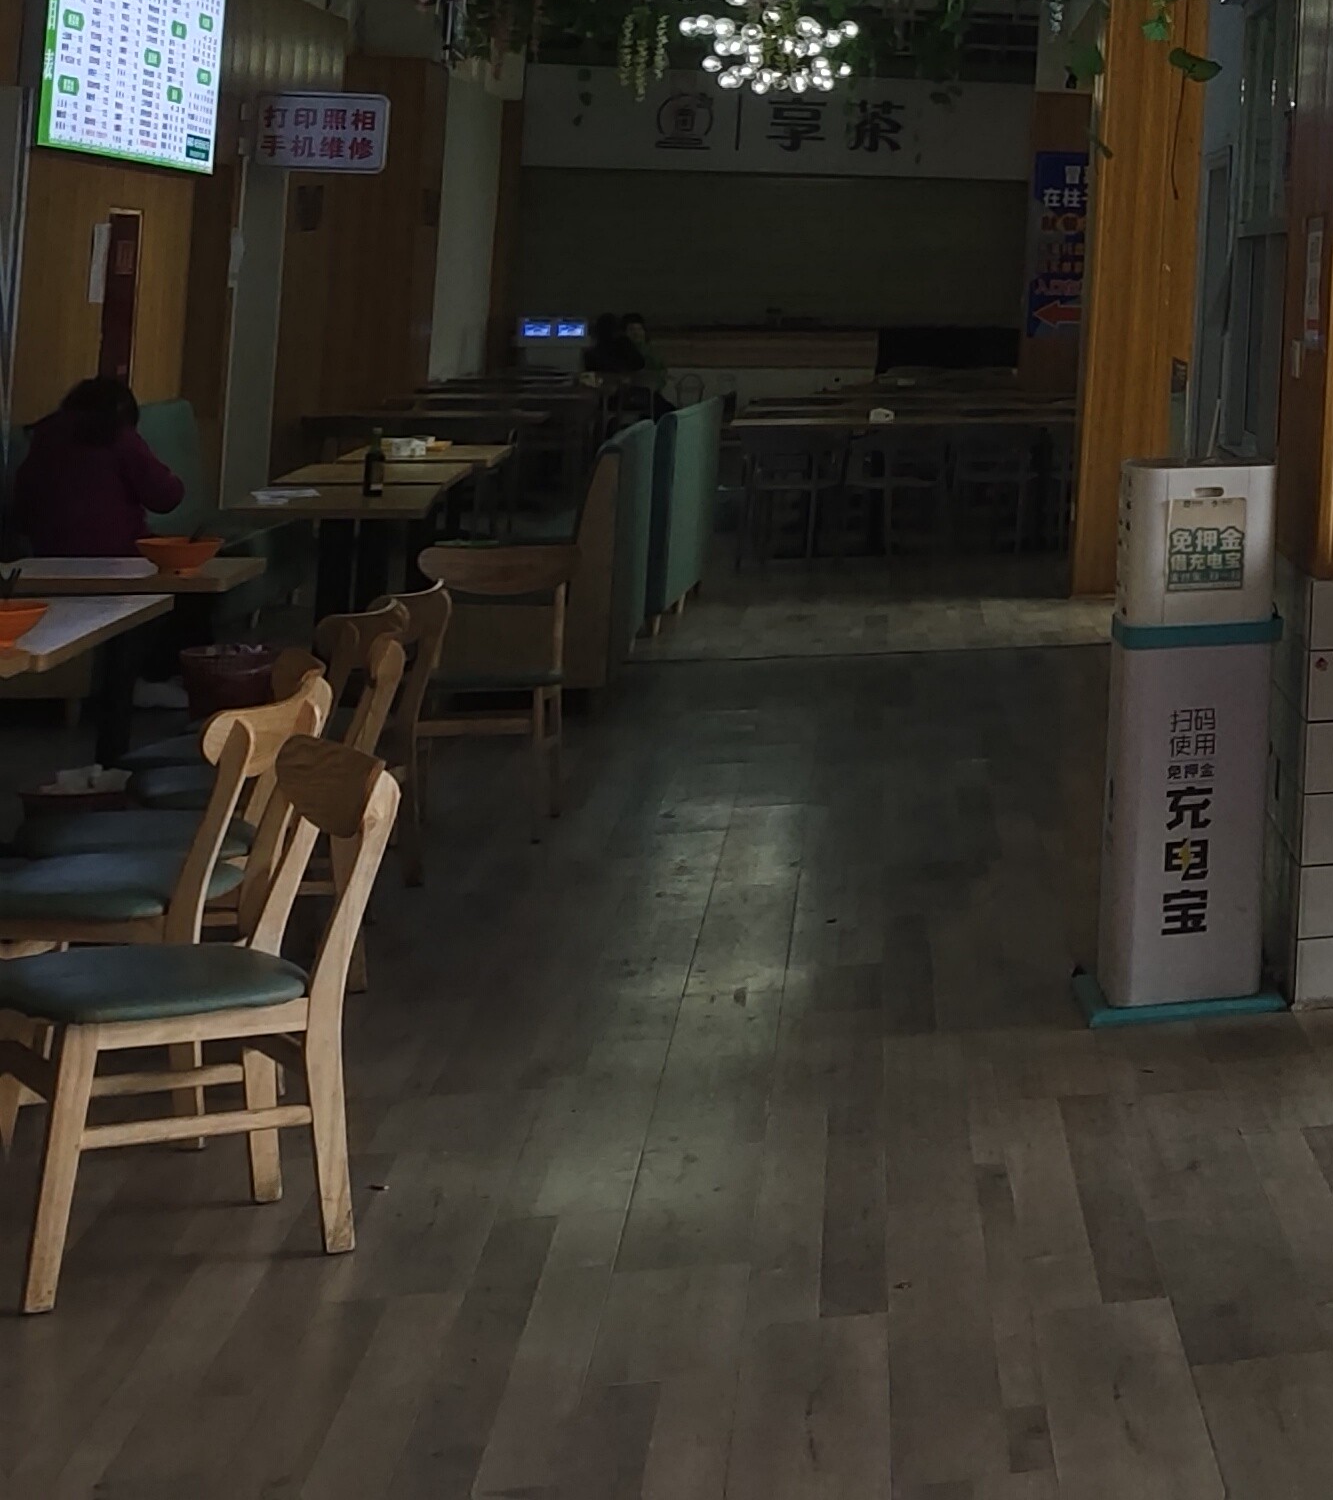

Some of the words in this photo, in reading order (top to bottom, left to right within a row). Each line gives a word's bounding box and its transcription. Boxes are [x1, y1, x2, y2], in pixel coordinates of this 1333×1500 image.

[263, 105, 377, 132] 打印照相
[261, 134, 374, 160] 手机维修
[1171, 528, 1243, 552] 免押金
[1170, 708, 1216, 734] 扫码
[1169, 734, 1216, 758] 使用
[1166, 762, 1215, 781] 免押金
[1161, 786, 1213, 936] 充电宝
